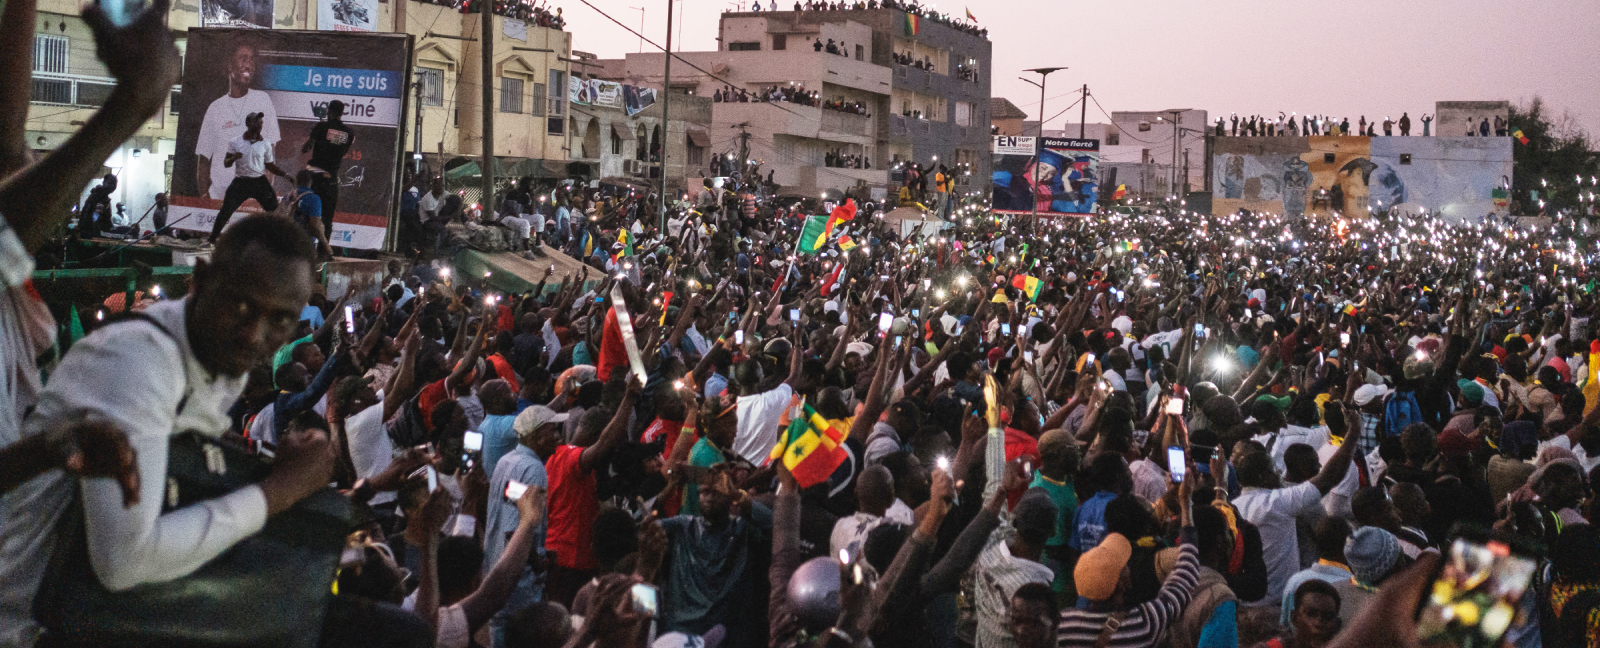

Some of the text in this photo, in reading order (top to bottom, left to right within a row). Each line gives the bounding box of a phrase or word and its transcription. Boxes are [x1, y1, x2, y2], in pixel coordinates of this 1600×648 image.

[304, 69, 387, 91] Je me suis
[310, 98, 376, 118] vaciné
[1045, 139, 1069, 147] Notre
